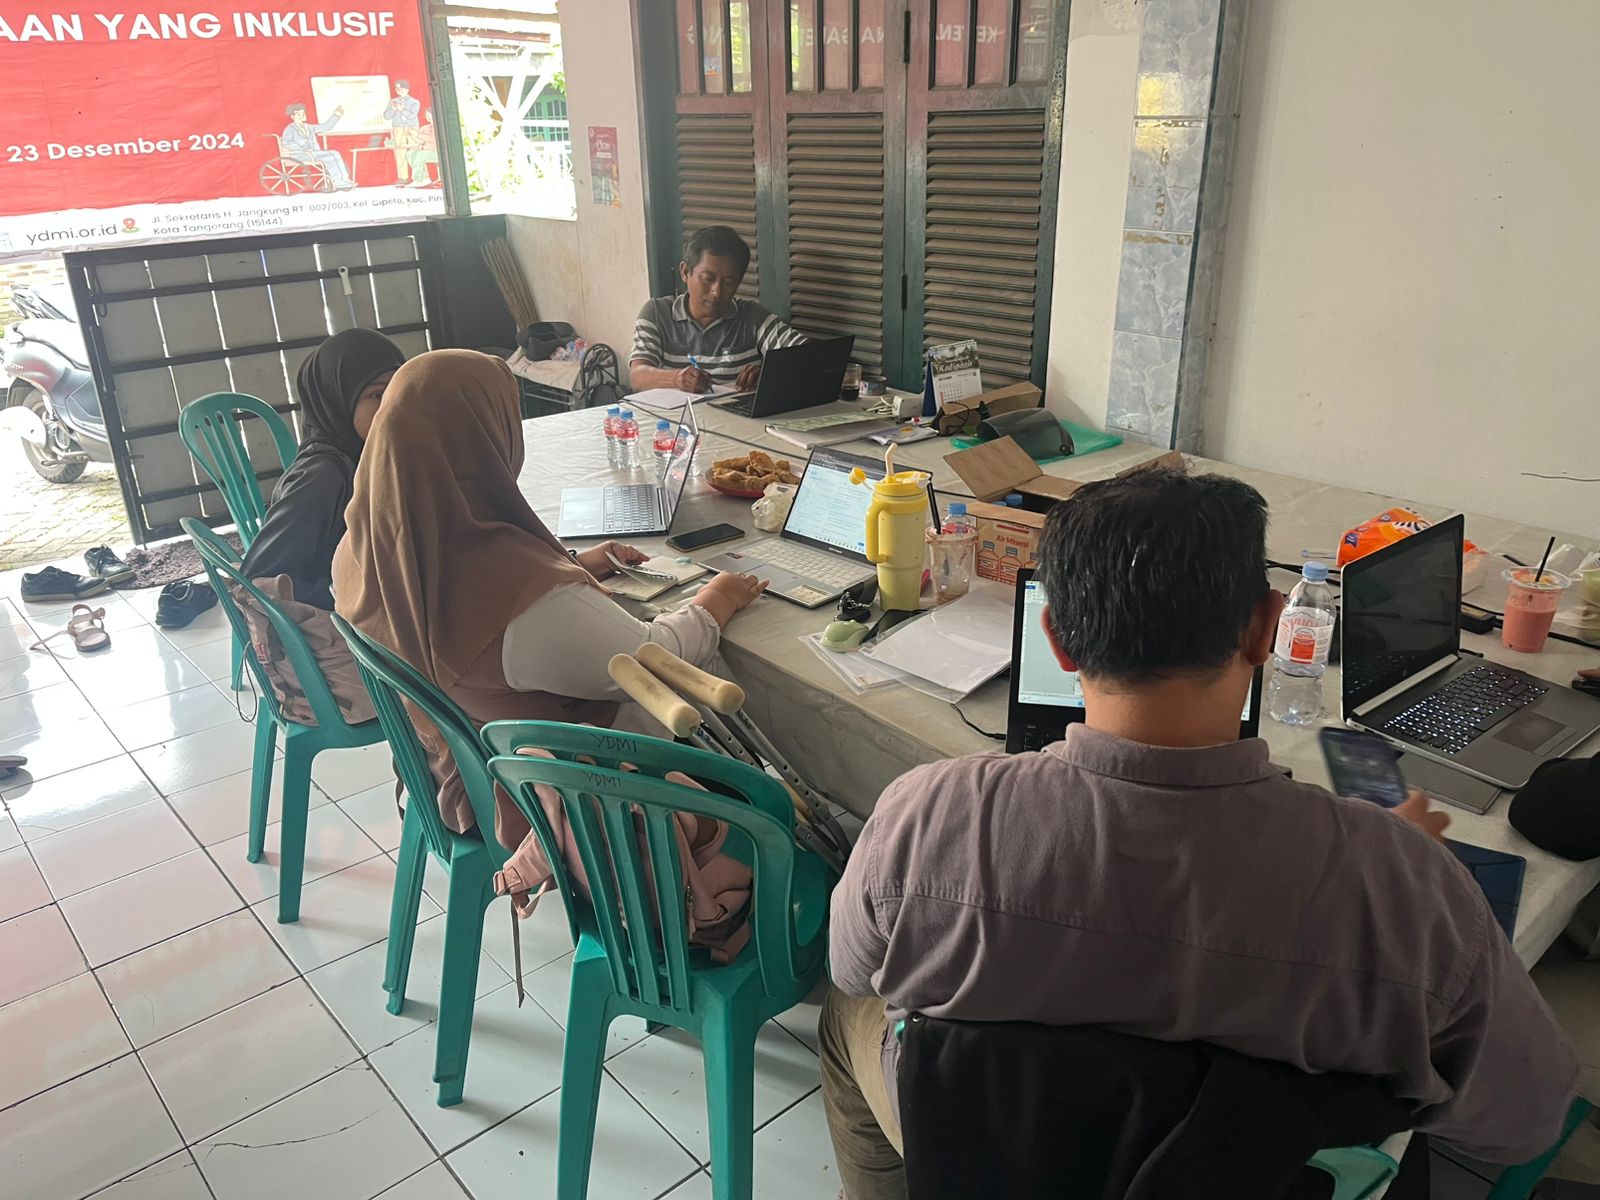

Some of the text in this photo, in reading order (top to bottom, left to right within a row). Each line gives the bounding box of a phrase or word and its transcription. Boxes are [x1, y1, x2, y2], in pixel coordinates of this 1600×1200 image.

[94, 13, 222, 40] YANG
[232, 12, 395, 38] INKLUSIF
[7, 132, 245, 163] 23 Desember 2024
[237, 206, 290, 217] Jangkung
[27, 224, 118, 246] ydmi.or.id
[153, 226, 180, 235] Kota
[246, 216, 283, 229] (15144)
[591, 733, 637, 753] YDMI
[583, 771, 622, 787] YDMI
